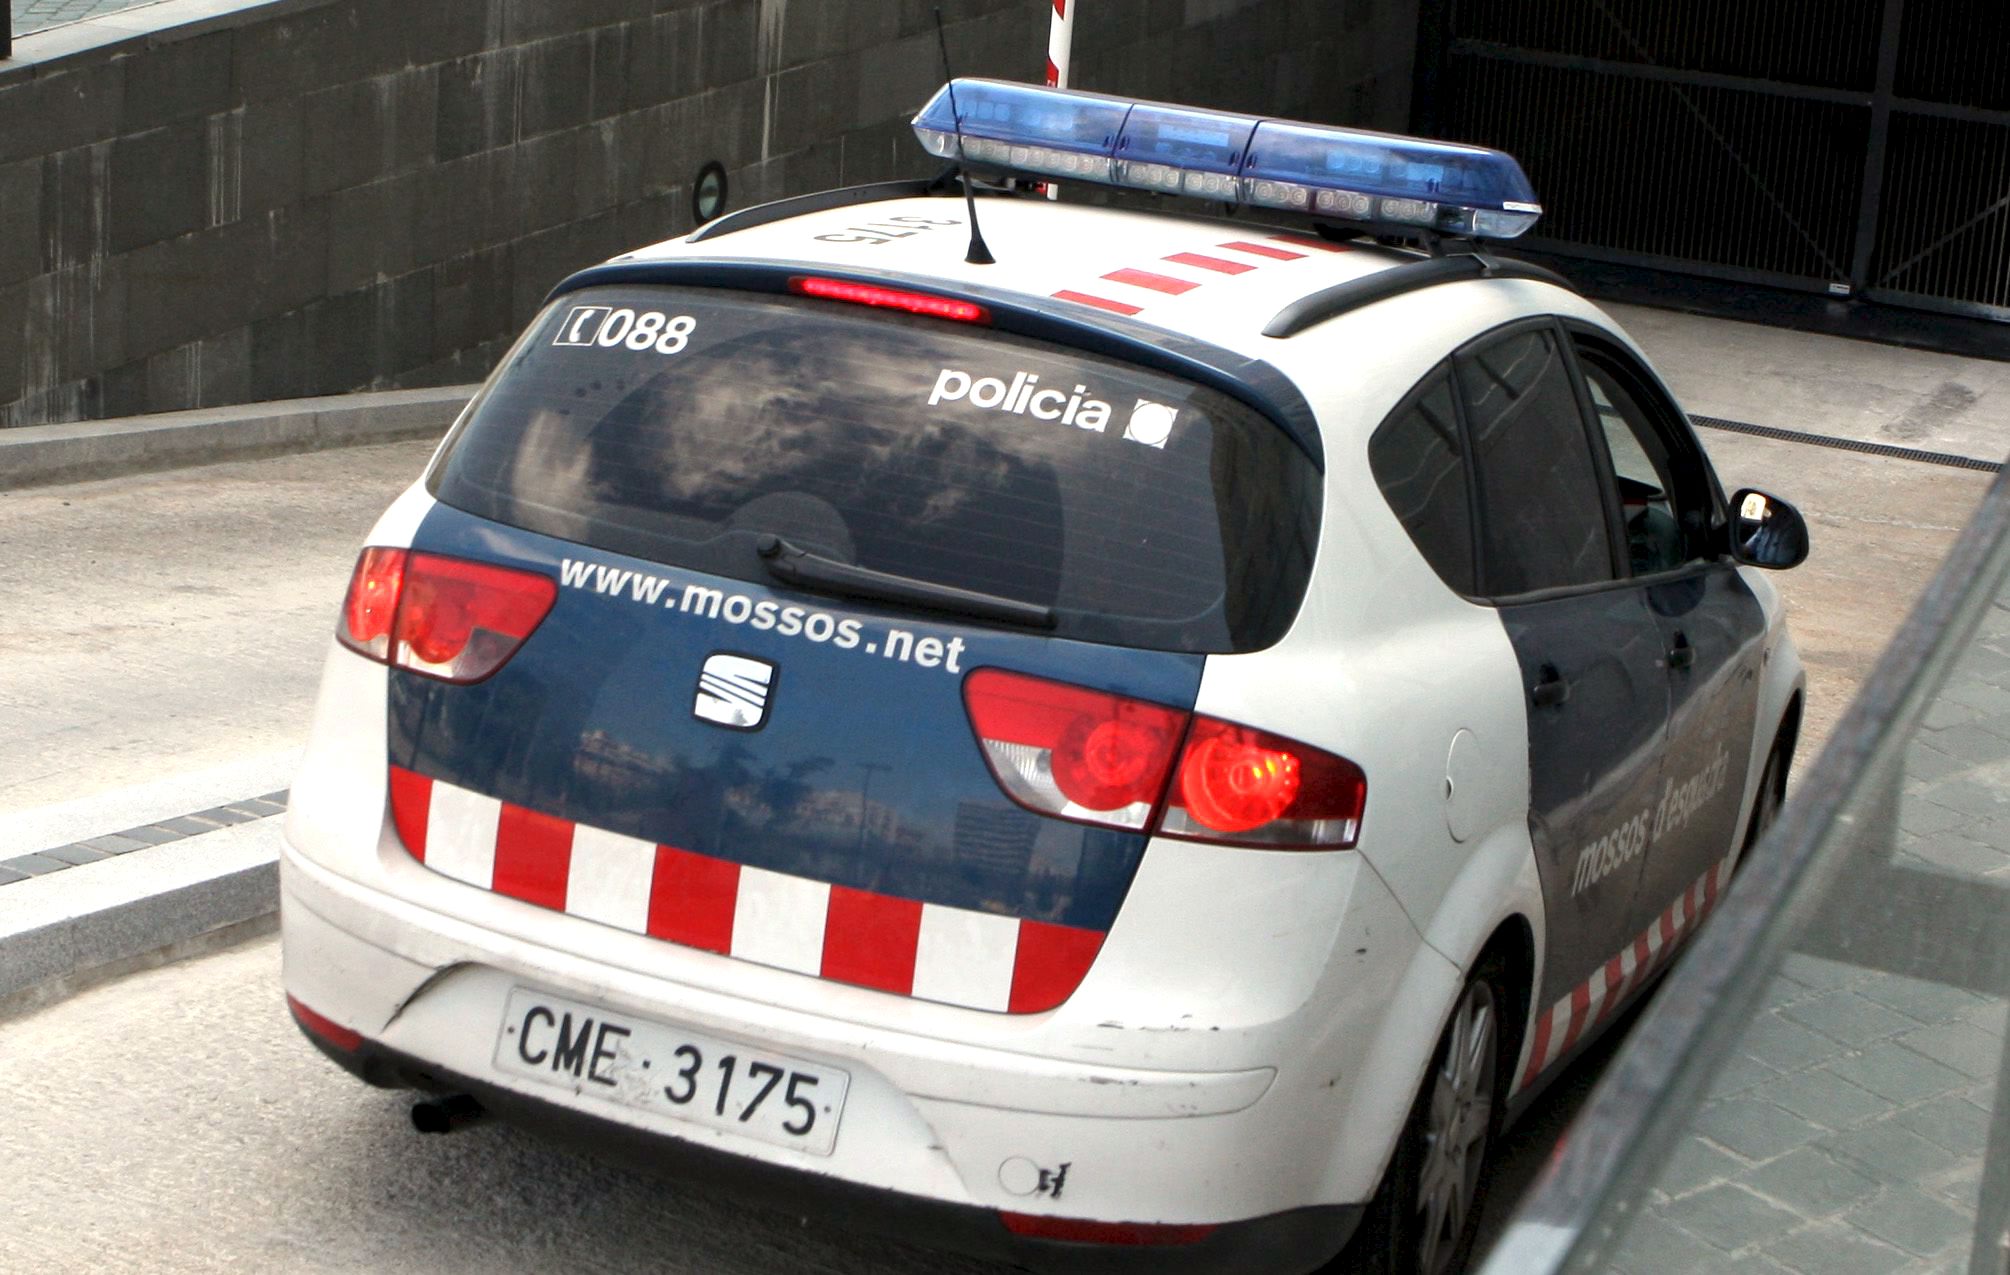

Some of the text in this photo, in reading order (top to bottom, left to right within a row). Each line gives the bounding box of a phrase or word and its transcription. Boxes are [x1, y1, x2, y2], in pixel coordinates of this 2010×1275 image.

[813, 215, 962, 245] 3175
[598, 308, 697, 355] 088
[927, 368, 1112, 433] policia
[559, 558, 966, 674] www.mossos.net
[1570, 808, 1649, 897] mossos
[663, 1044, 820, 1136] 3175
